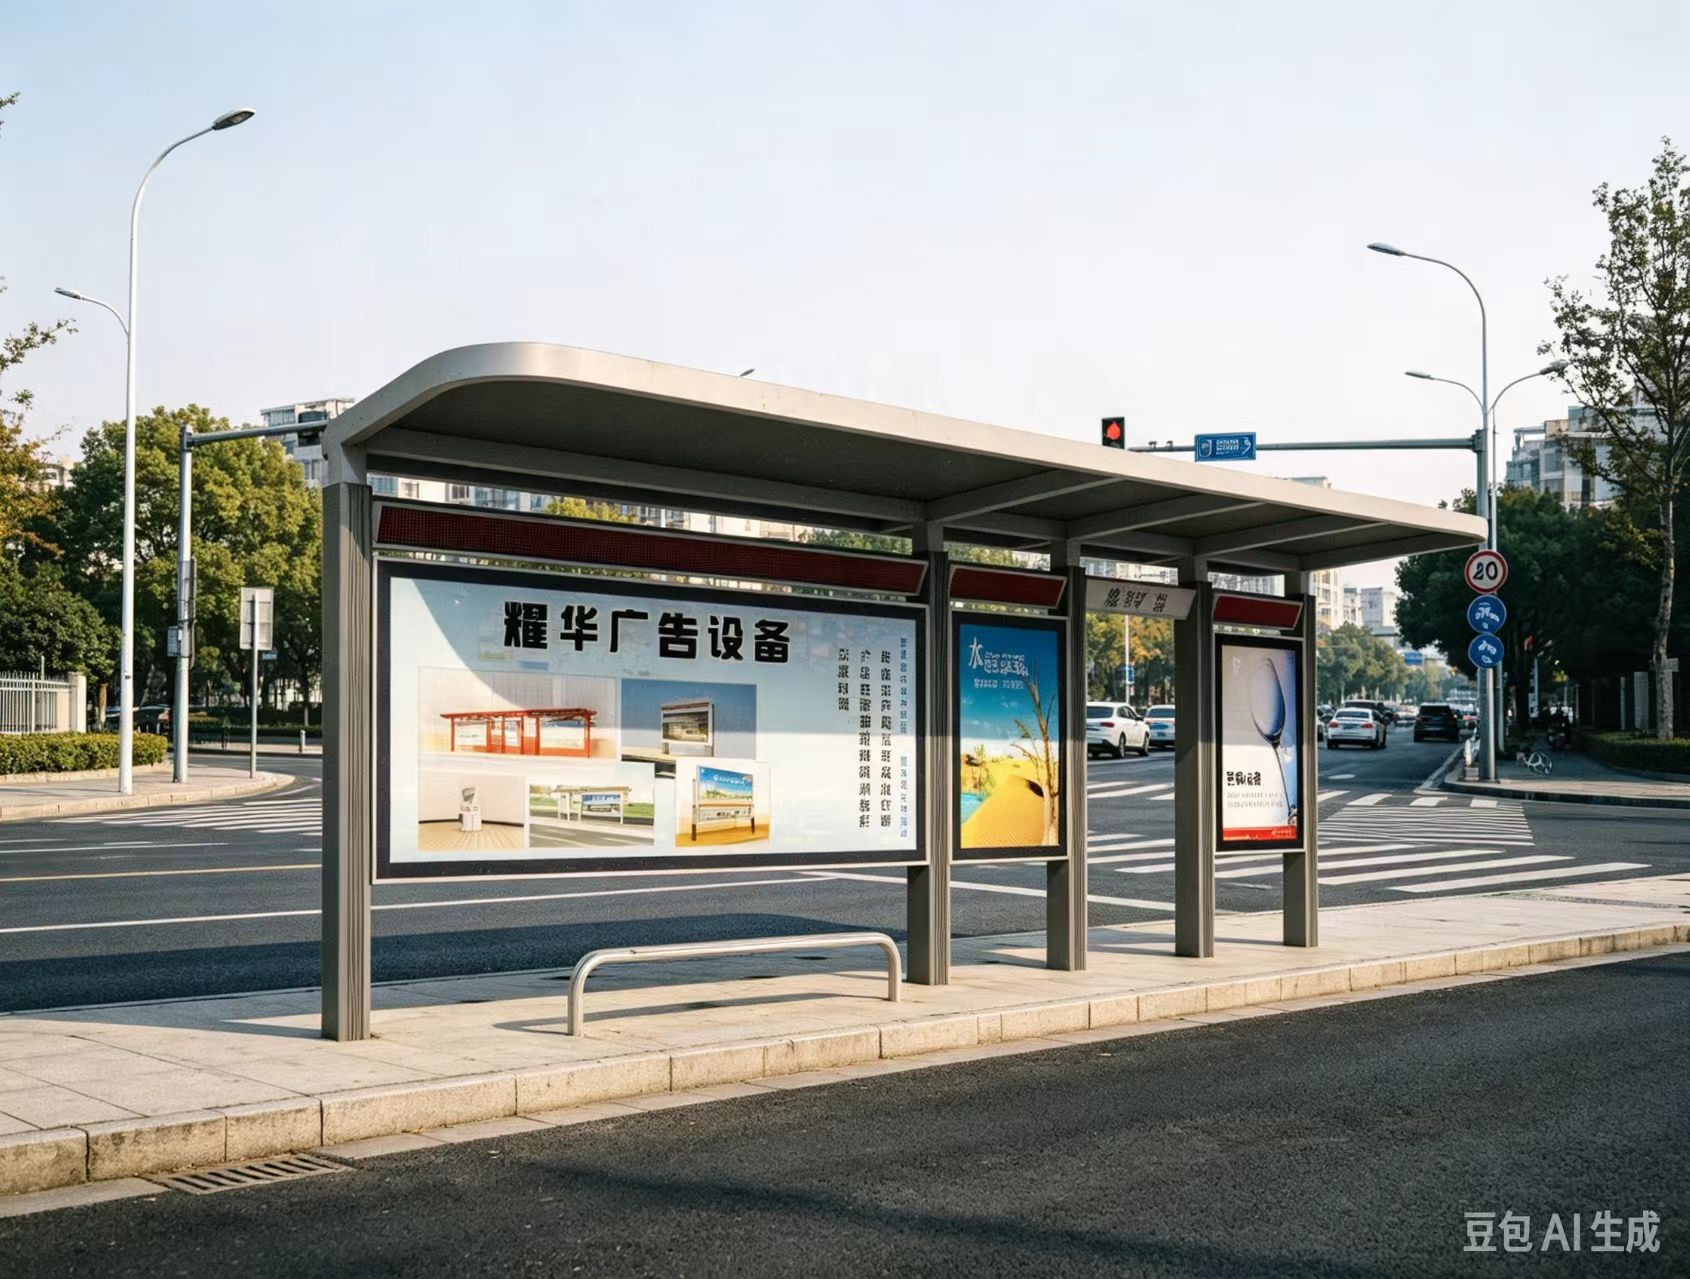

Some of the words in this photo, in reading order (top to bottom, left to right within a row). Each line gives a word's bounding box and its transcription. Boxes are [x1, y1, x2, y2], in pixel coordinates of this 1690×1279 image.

[1473, 561, 1498, 580] 20
[504, 601, 790, 664] 耀华广告设备
